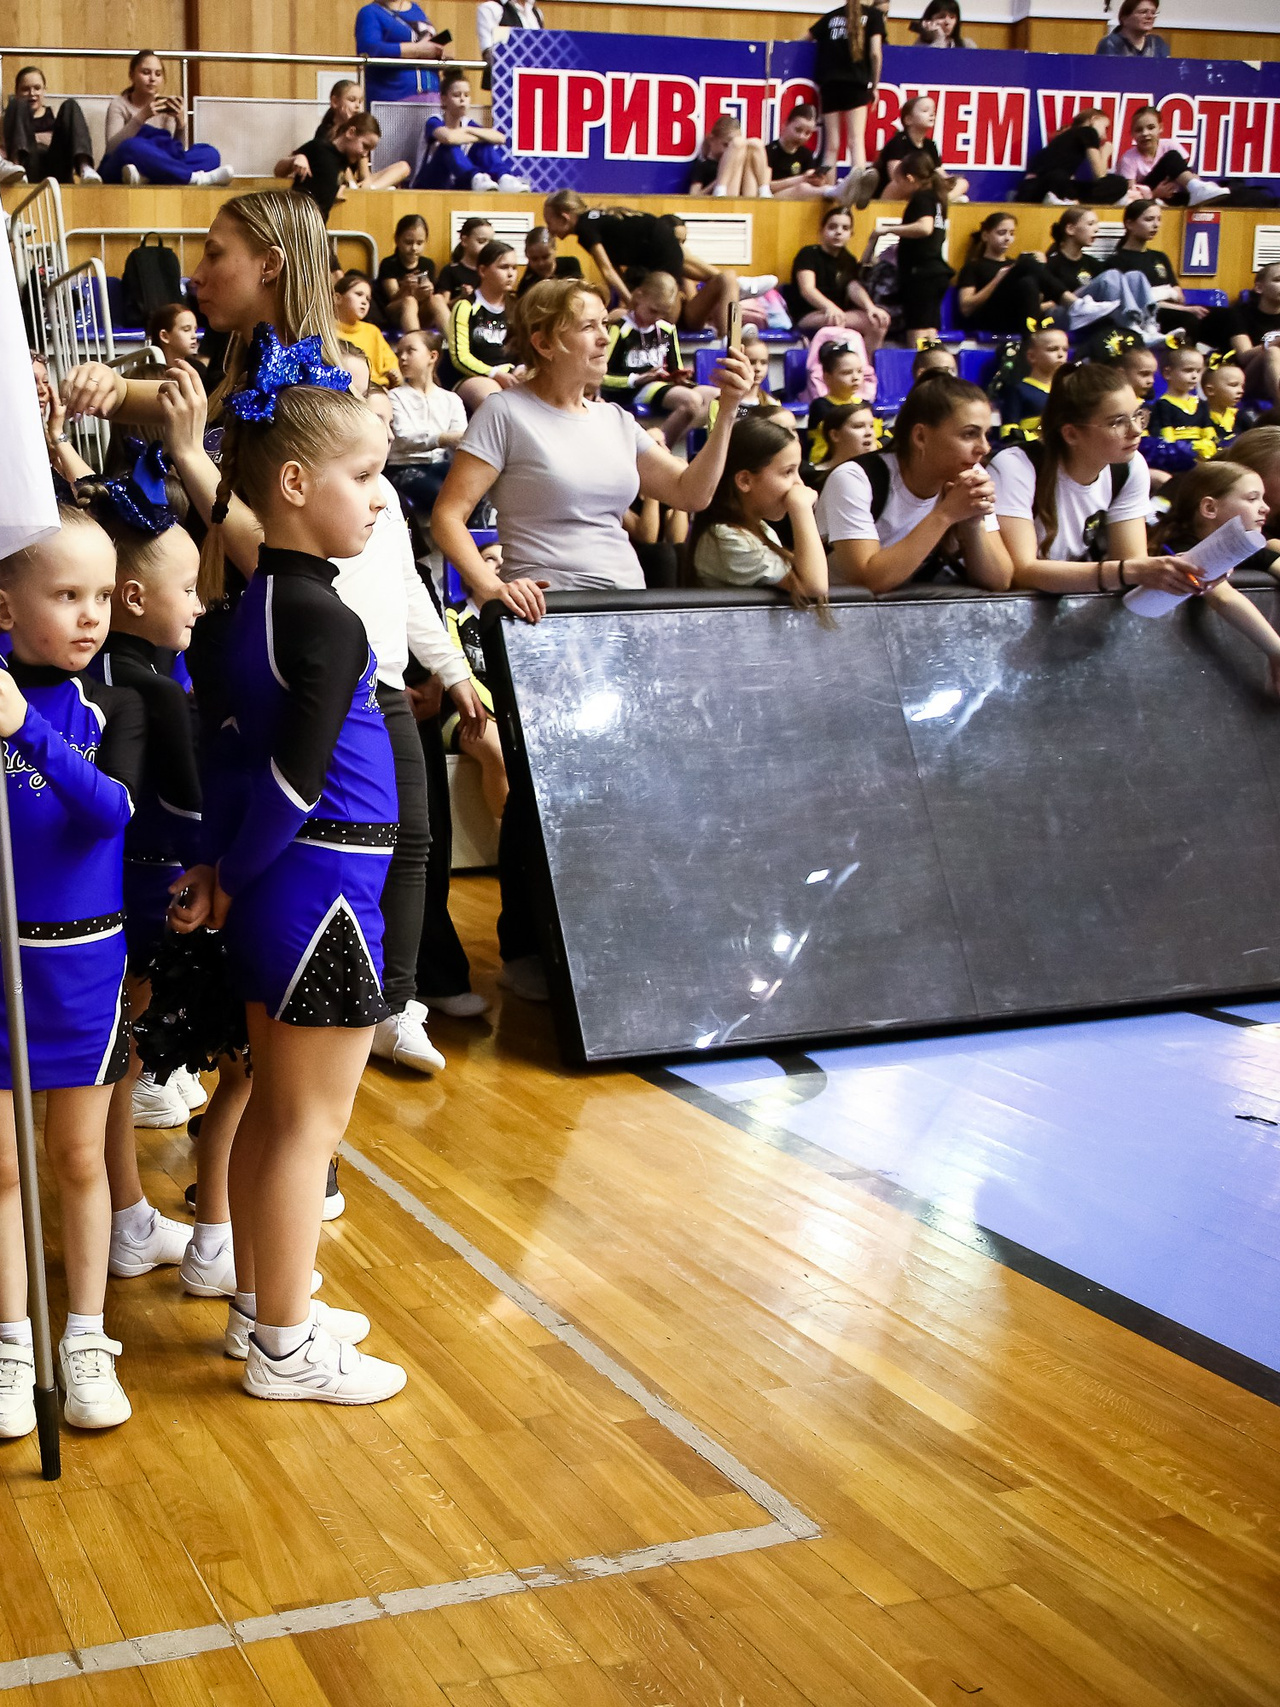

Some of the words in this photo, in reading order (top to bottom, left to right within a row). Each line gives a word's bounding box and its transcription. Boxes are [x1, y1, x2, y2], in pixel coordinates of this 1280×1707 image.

[512, 68, 1030, 172] ПРИВЕТСВЕМ
[1036, 89, 1280, 178] УЧАСТН
[1190, 232, 1209, 266] А
